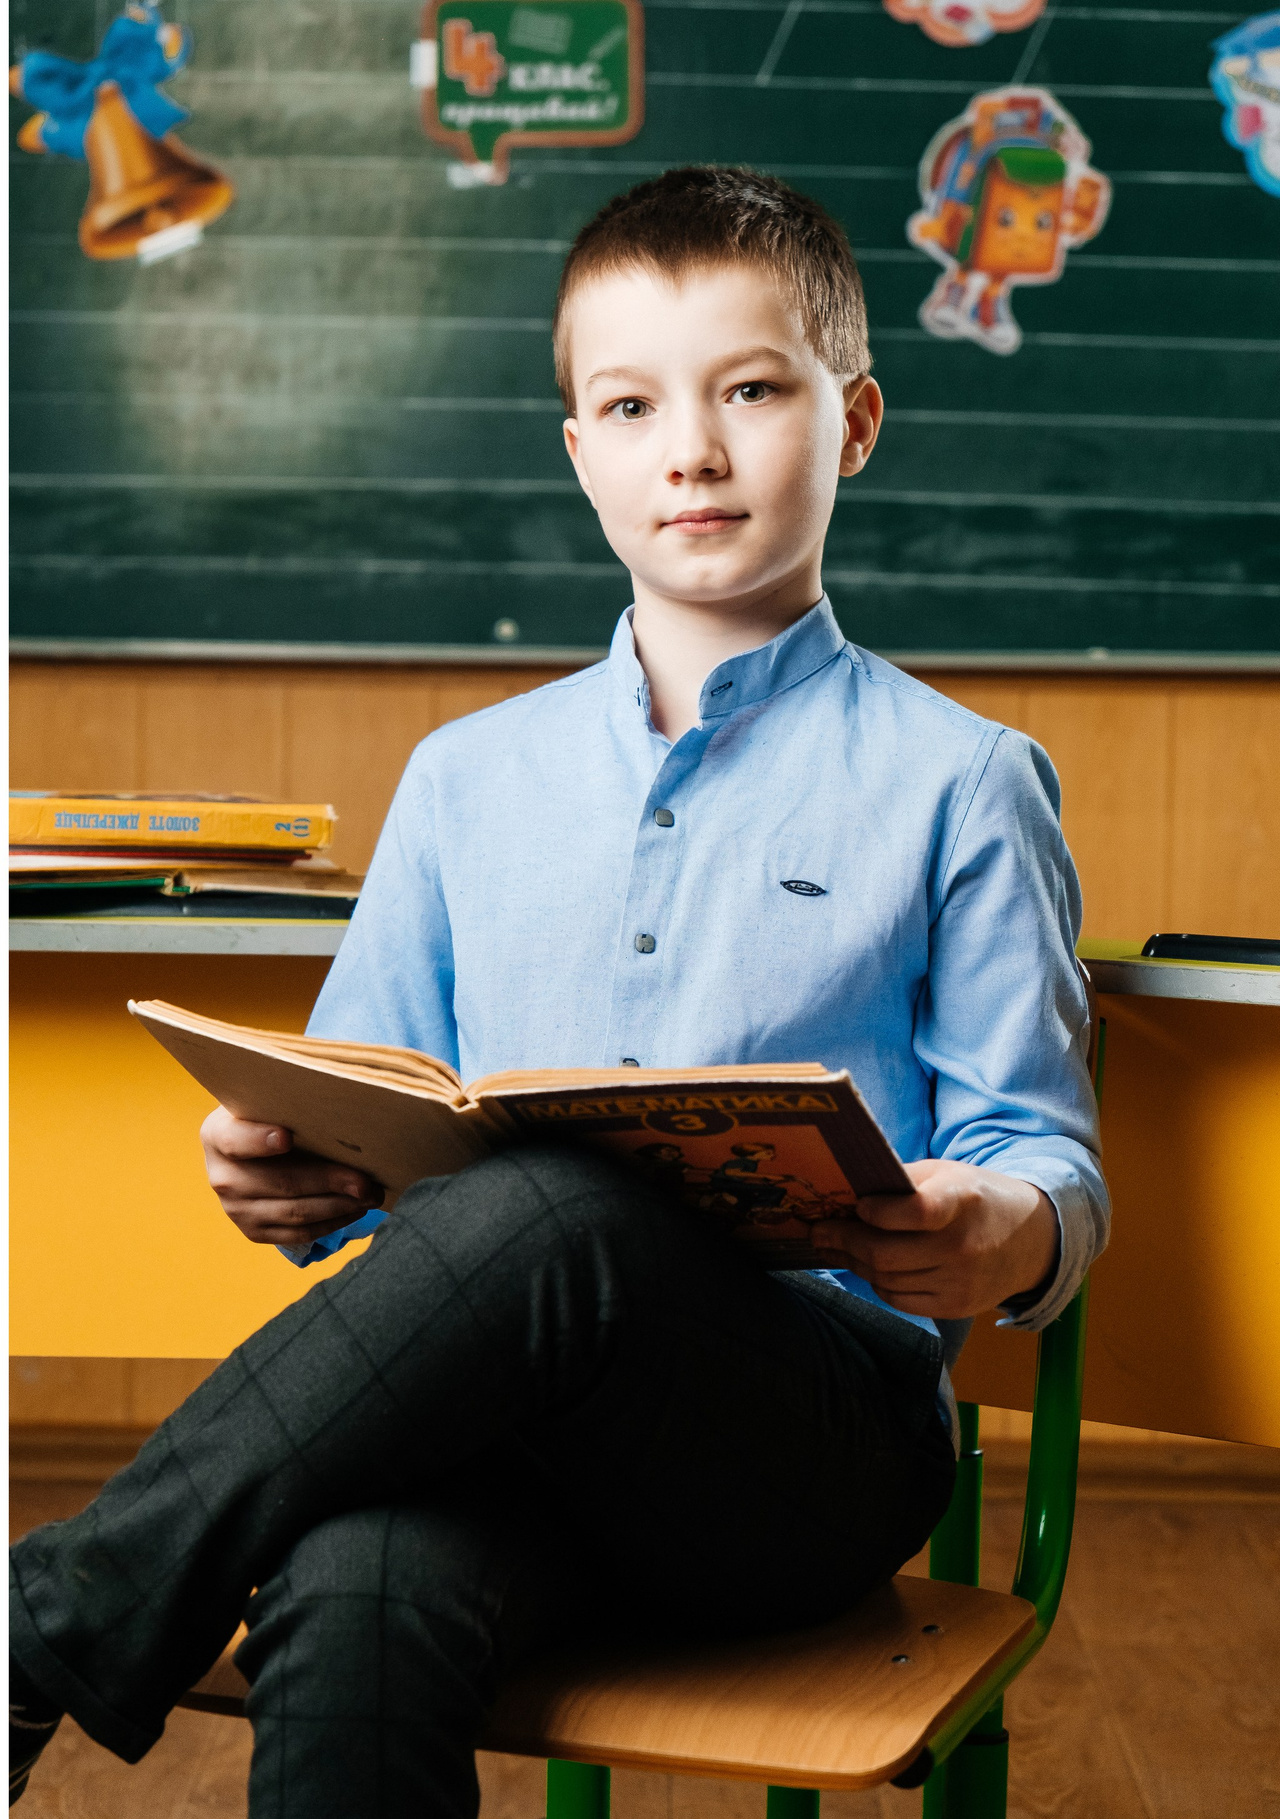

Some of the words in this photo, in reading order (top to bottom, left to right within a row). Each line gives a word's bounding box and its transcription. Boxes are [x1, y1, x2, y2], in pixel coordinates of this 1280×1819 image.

[54, 811, 140, 829] ДЖЕРЕЛЬЦЕ
[149, 815, 200, 831] ЗОЛОТЕ
[531, 1091, 828, 1118] МАТЕМАТИКА
[671, 1113, 707, 1132] 3
